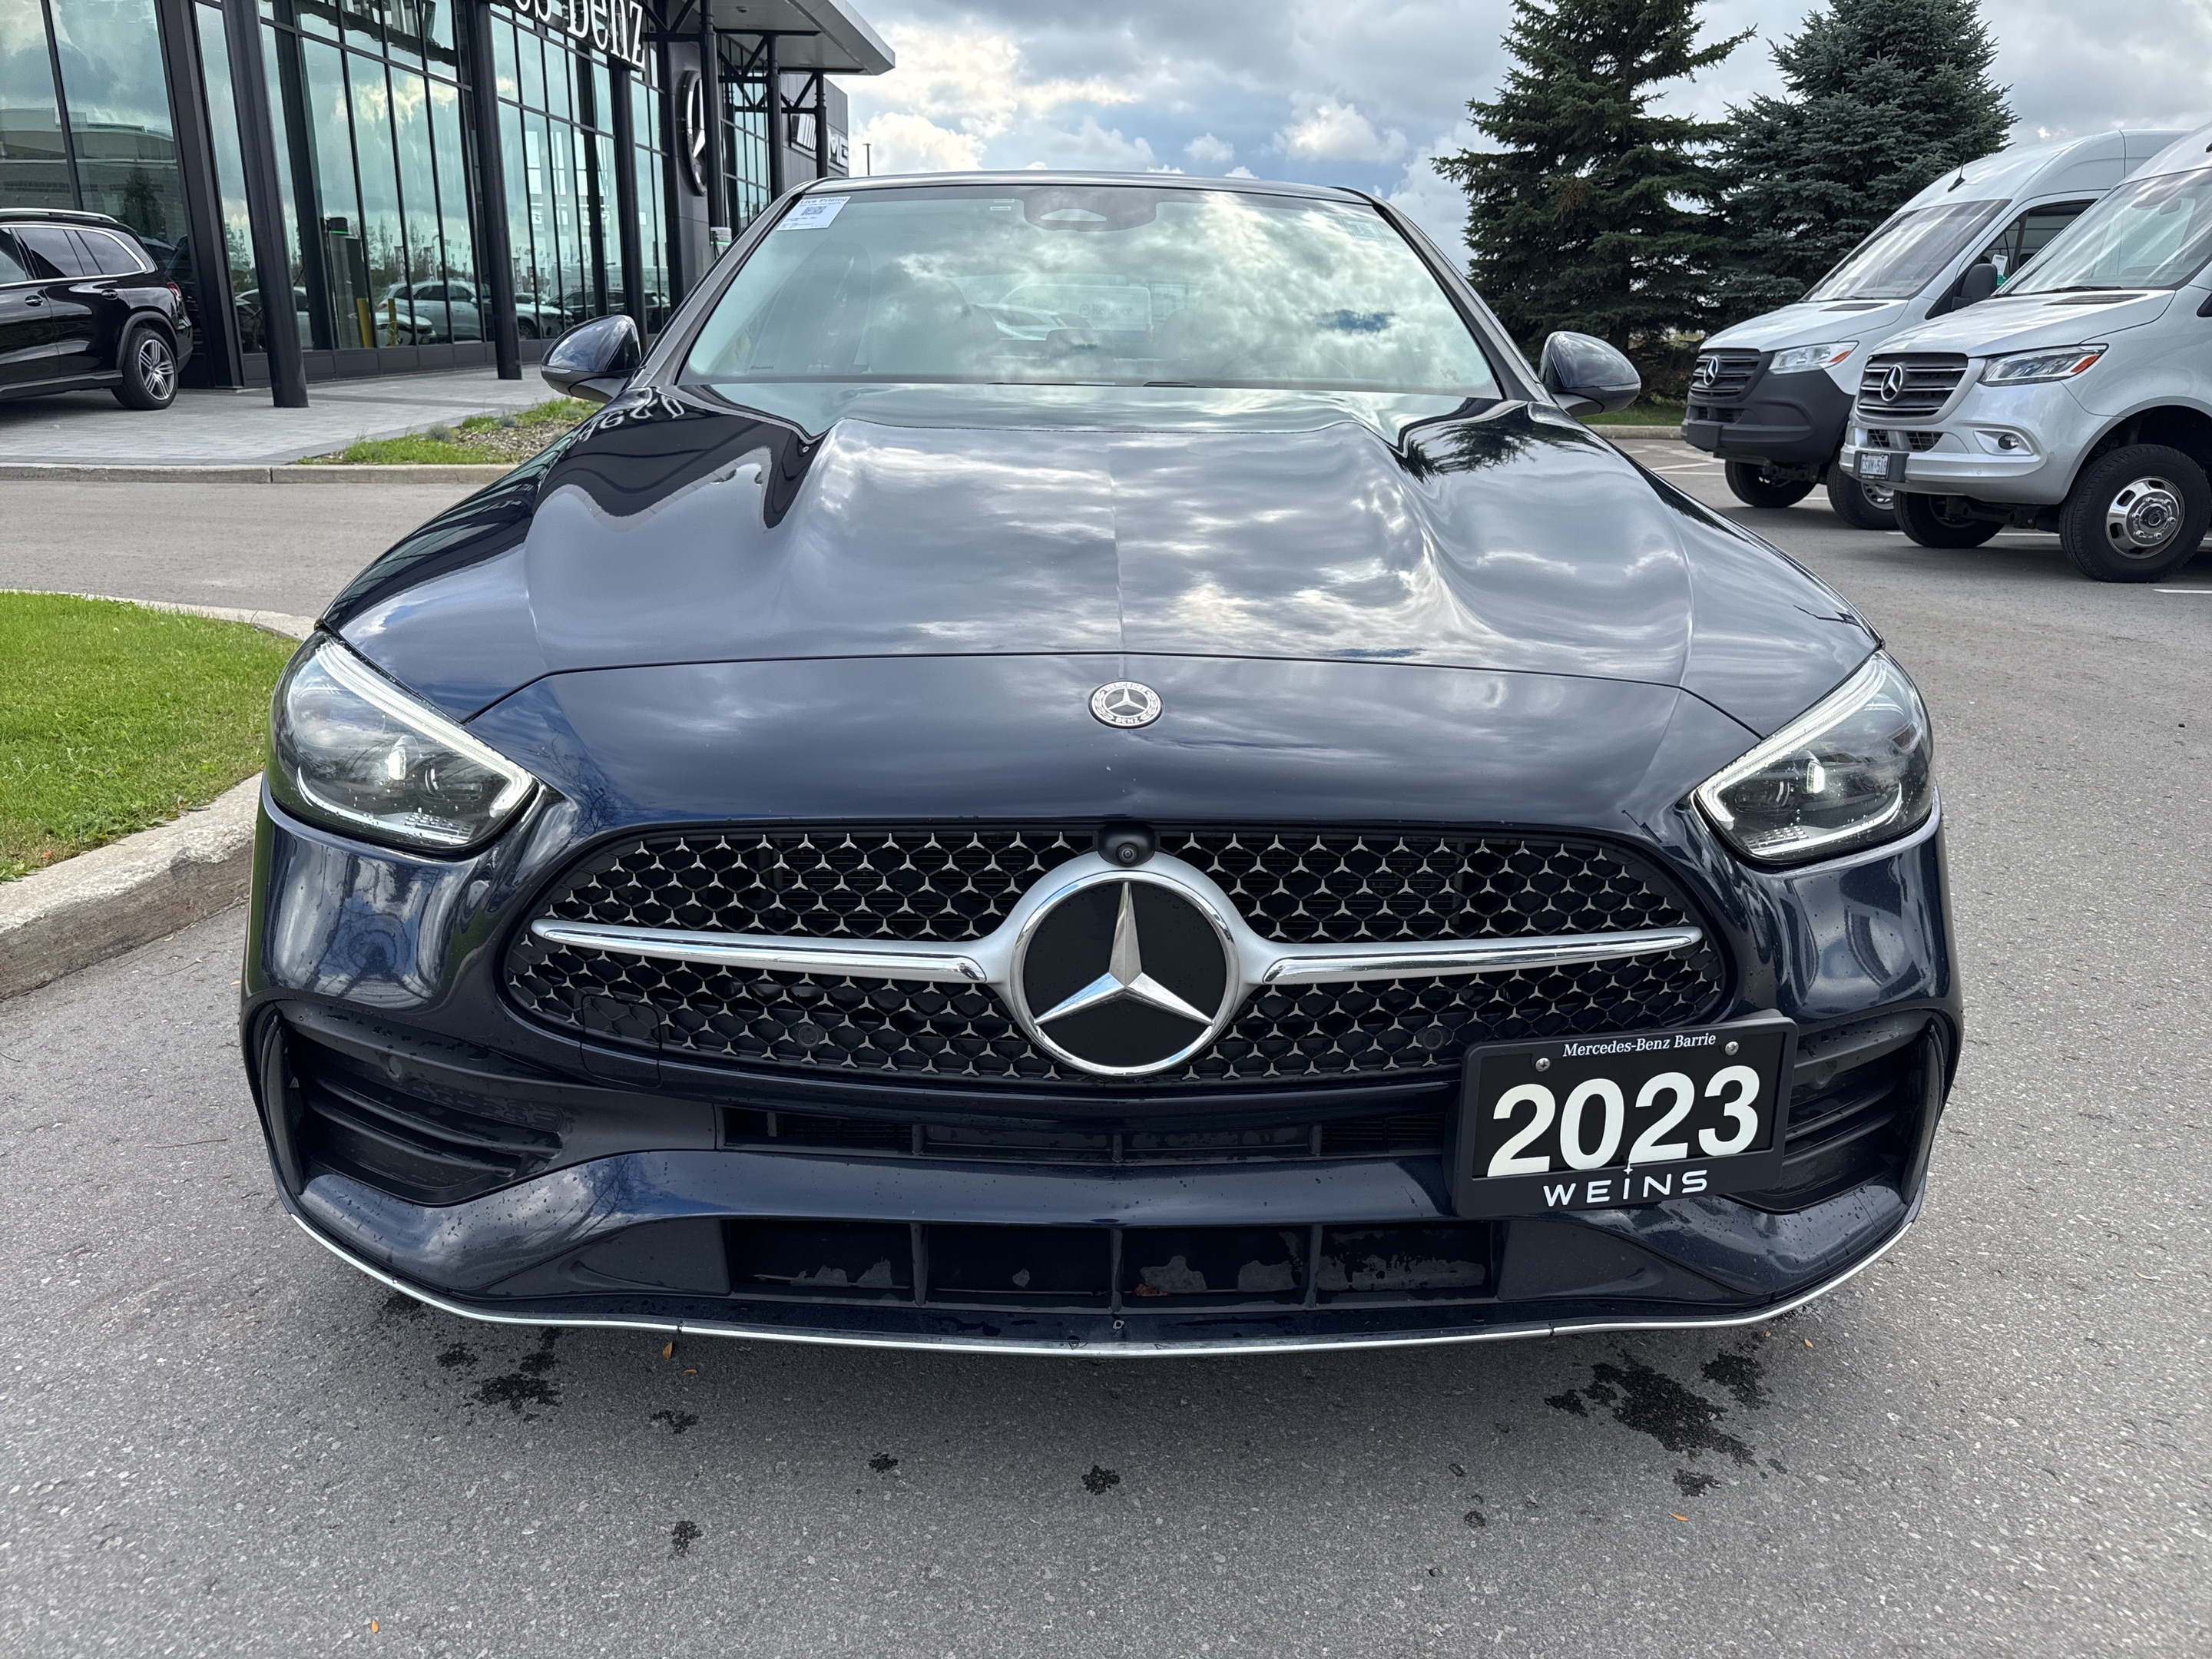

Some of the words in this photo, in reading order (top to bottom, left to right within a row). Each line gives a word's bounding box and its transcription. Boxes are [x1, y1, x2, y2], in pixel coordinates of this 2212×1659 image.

[1562, 1038, 1671, 1057] Mercedes-Benz
[1673, 1033, 1716, 1048] Barrie
[1488, 1065, 1760, 1177] 2023
[1543, 1170, 1707, 1207] WEINS
